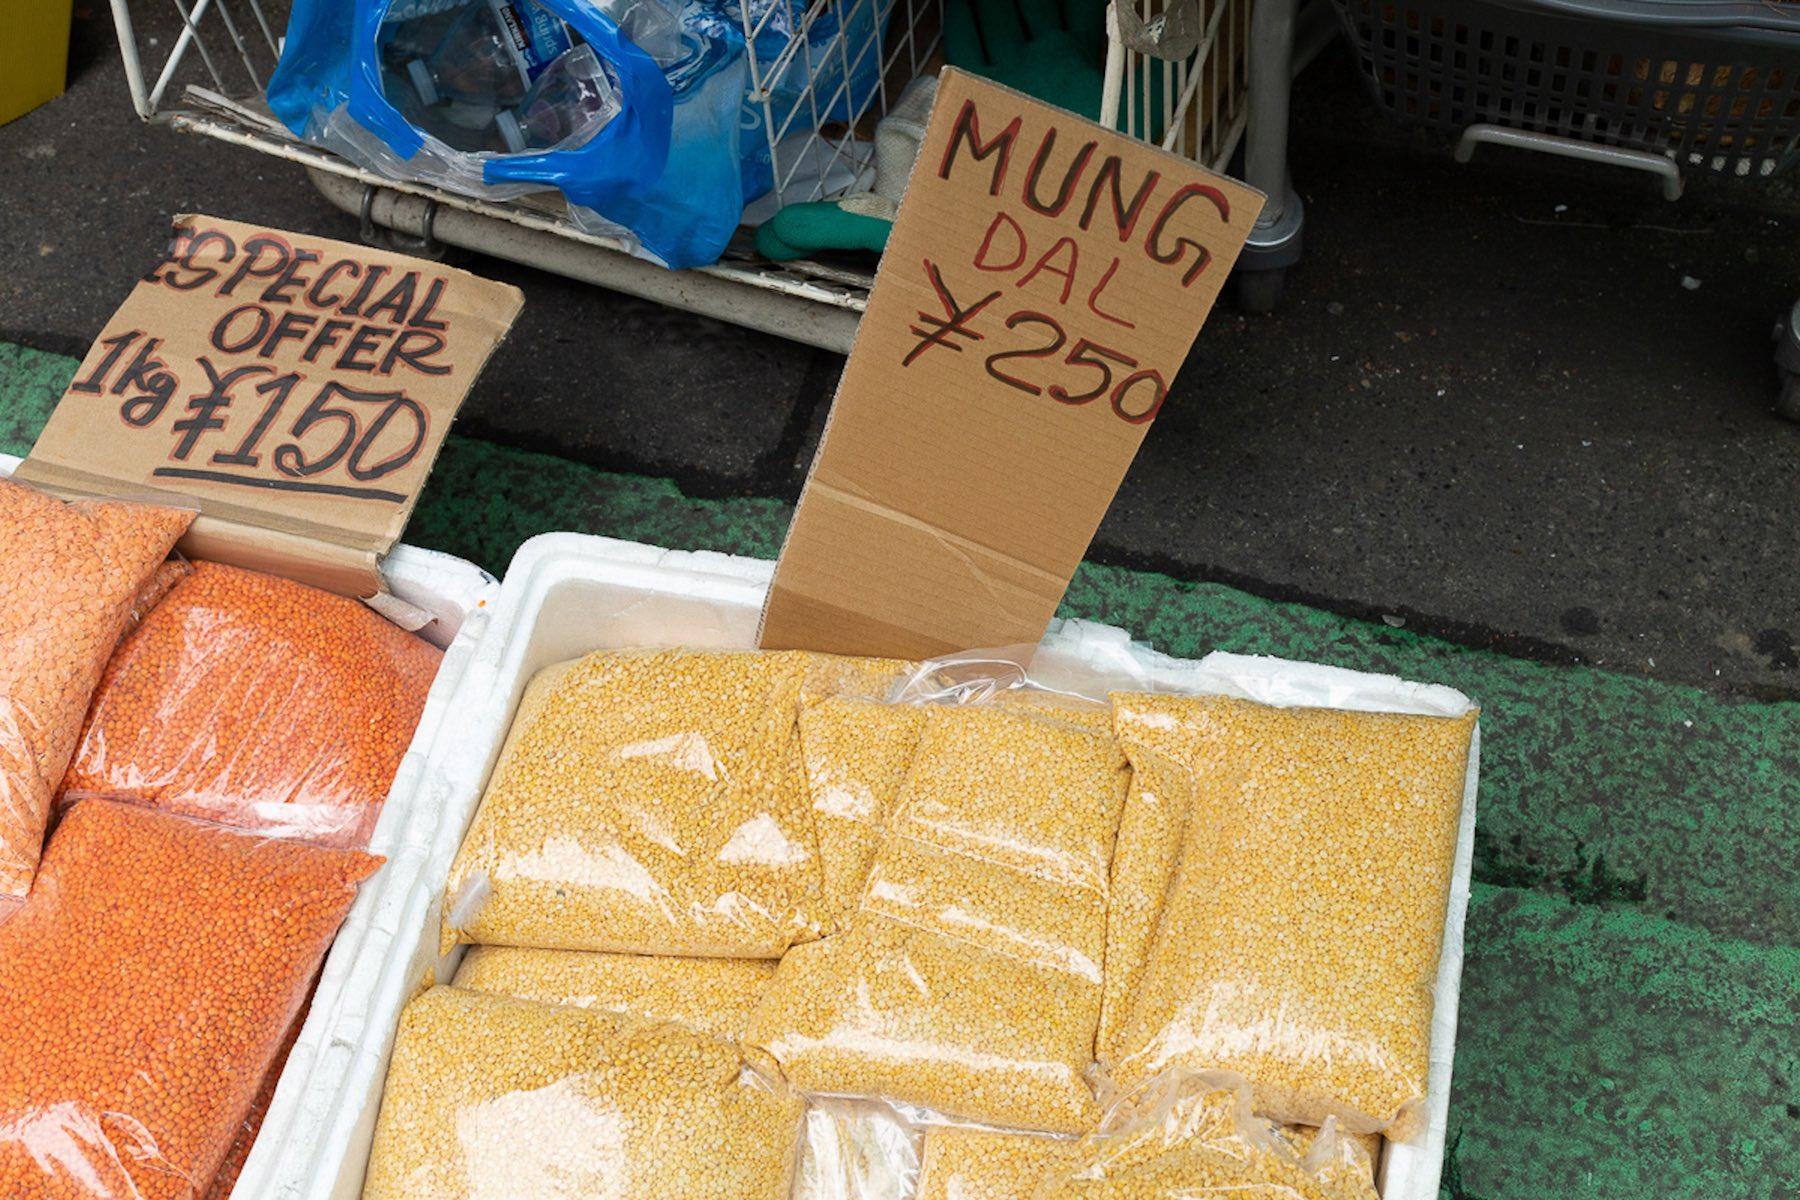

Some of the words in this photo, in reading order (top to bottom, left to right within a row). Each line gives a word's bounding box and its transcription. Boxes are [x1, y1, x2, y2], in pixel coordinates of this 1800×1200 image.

[938, 99, 1230, 288] MUNG
[973, 211, 1135, 328] DAL
[69, 330, 180, 428] 1kg
[170, 357, 431, 482] ¥150
[210, 304, 454, 376] OFFER
[902, 258, 1168, 424] ¥250
